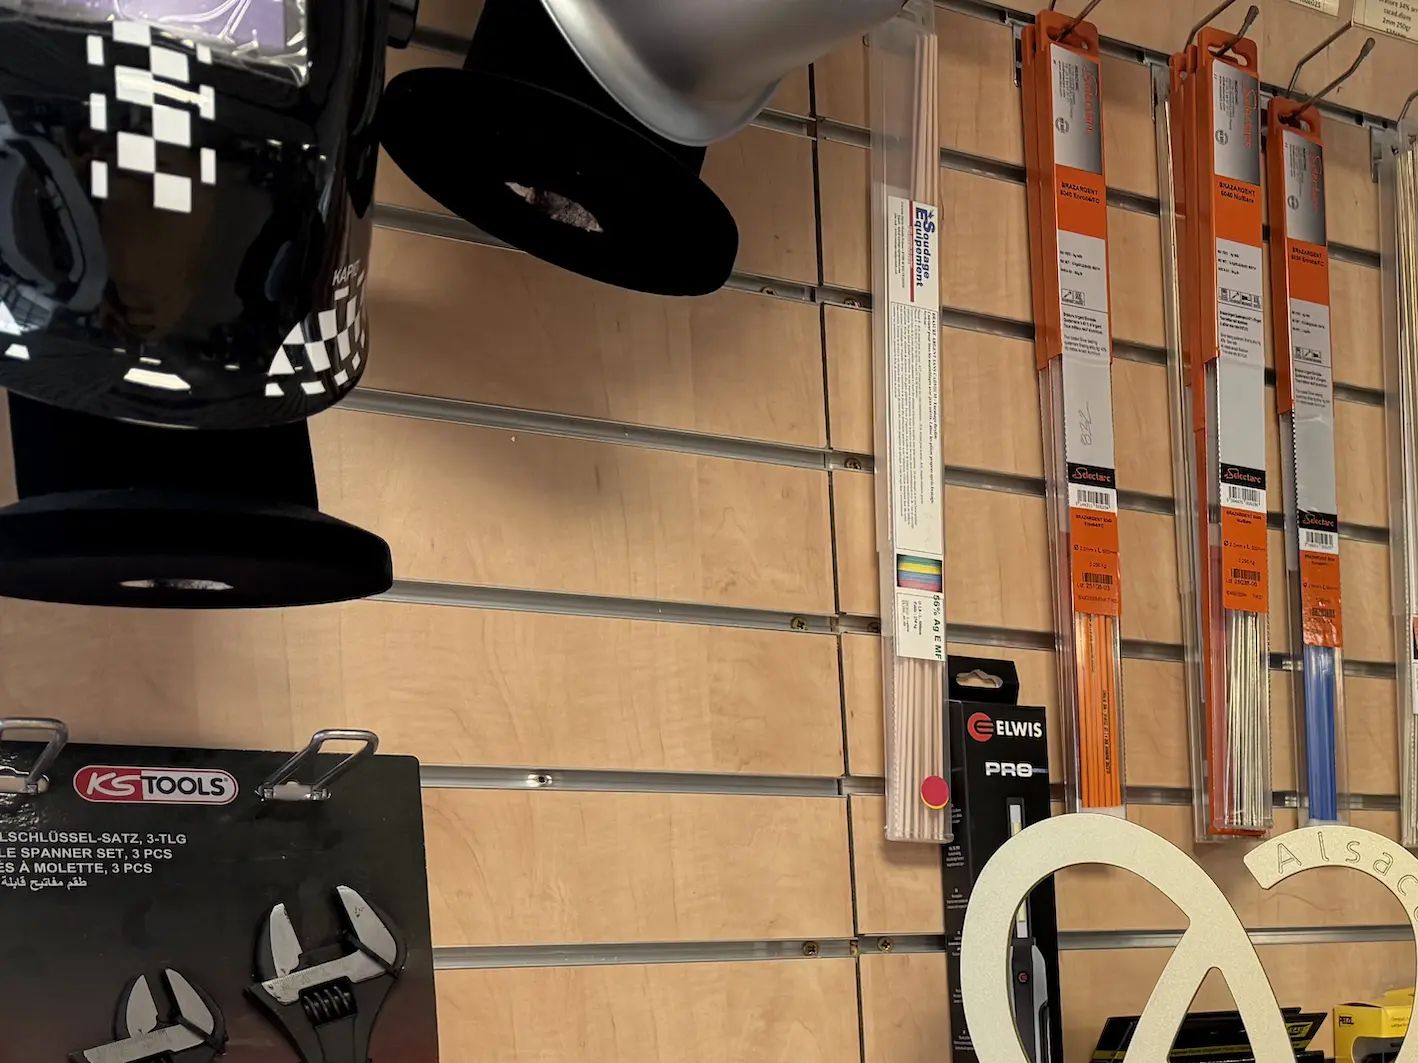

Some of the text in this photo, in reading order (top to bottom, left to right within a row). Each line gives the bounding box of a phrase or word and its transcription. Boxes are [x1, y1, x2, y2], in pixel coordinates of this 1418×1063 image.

[914, 207, 927, 287] Equipement
[922, 221, 935, 278] Soudage
[932, 619, 940, 631] Ag
[934, 644, 941, 659] MF
[996, 719, 1043, 738] ELWIS
[985, 761, 1033, 778] PRO
[146, 833, 187, 846] 3-TLG
[20, 847, 92, 860] SPANNER
[96, 848, 129, 861] SET,
[132, 849, 141, 860] 3
[144, 849, 173, 860] PCS
[19, 859, 31, 874] À
[34, 862, 108, 875] MOLETTE,
[111, 863, 119, 874] 3
[123, 863, 153, 874] PCS
